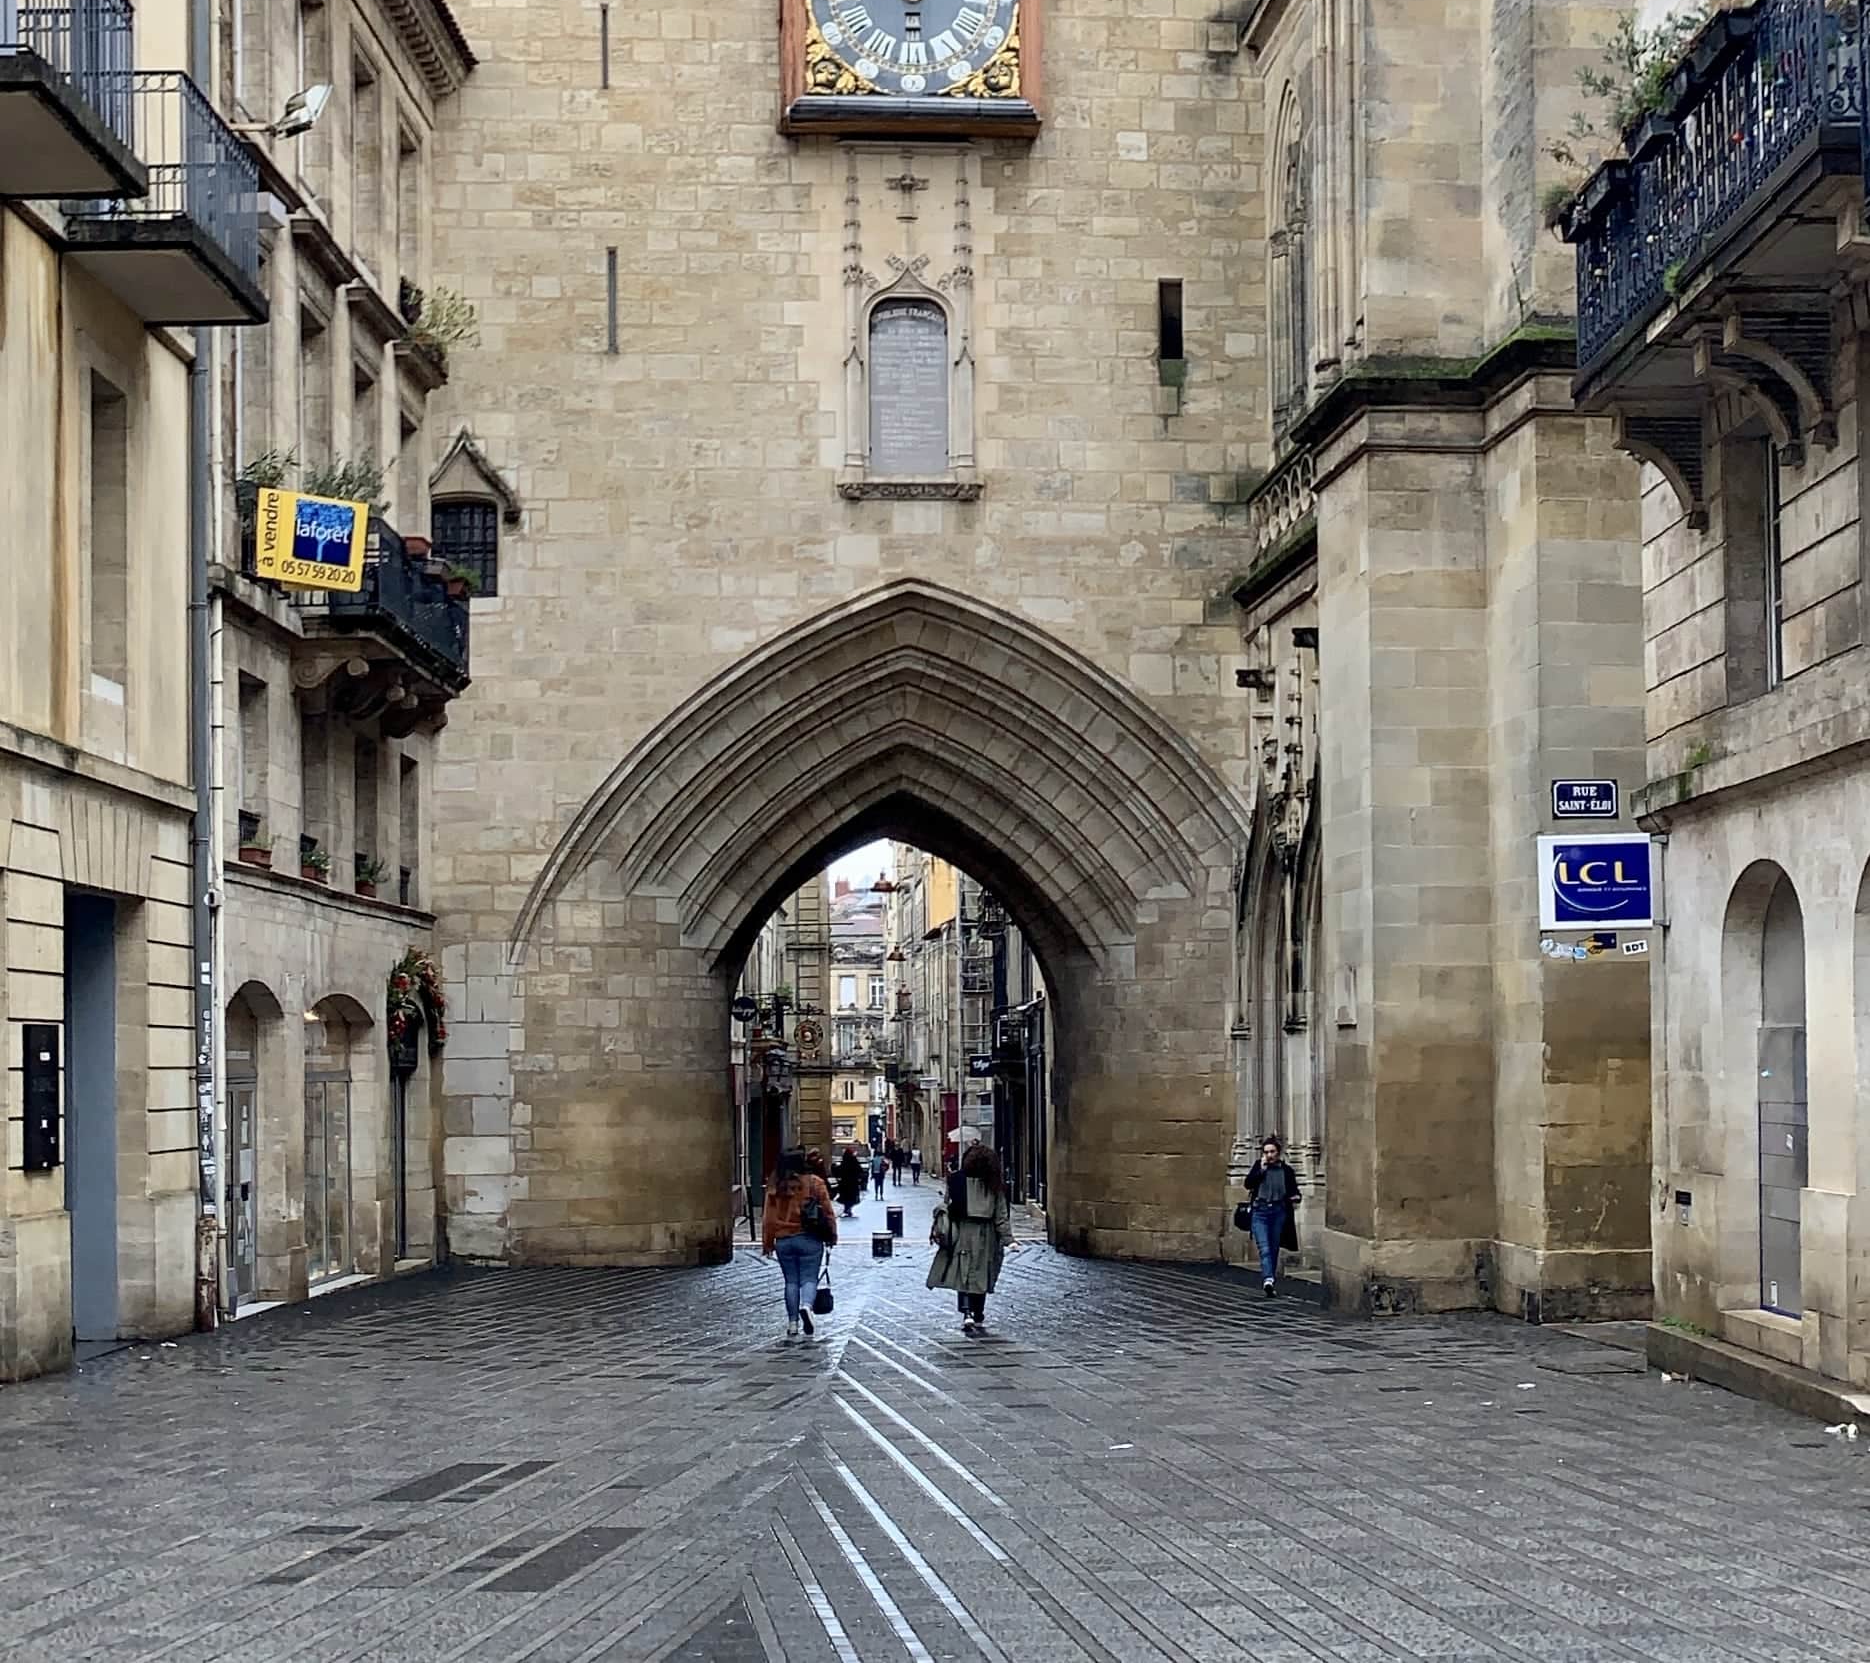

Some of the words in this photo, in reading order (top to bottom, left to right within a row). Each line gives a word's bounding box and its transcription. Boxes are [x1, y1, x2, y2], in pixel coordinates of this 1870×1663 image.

[262, 492, 280, 552] vendre
[281, 560, 296, 574] 05
[297, 562, 311, 577] 57
[327, 568, 341, 582] 20
[341, 570, 356, 584] 20
[1572, 785, 1598, 797] RUE
[1558, 861, 1638, 885] LCL
